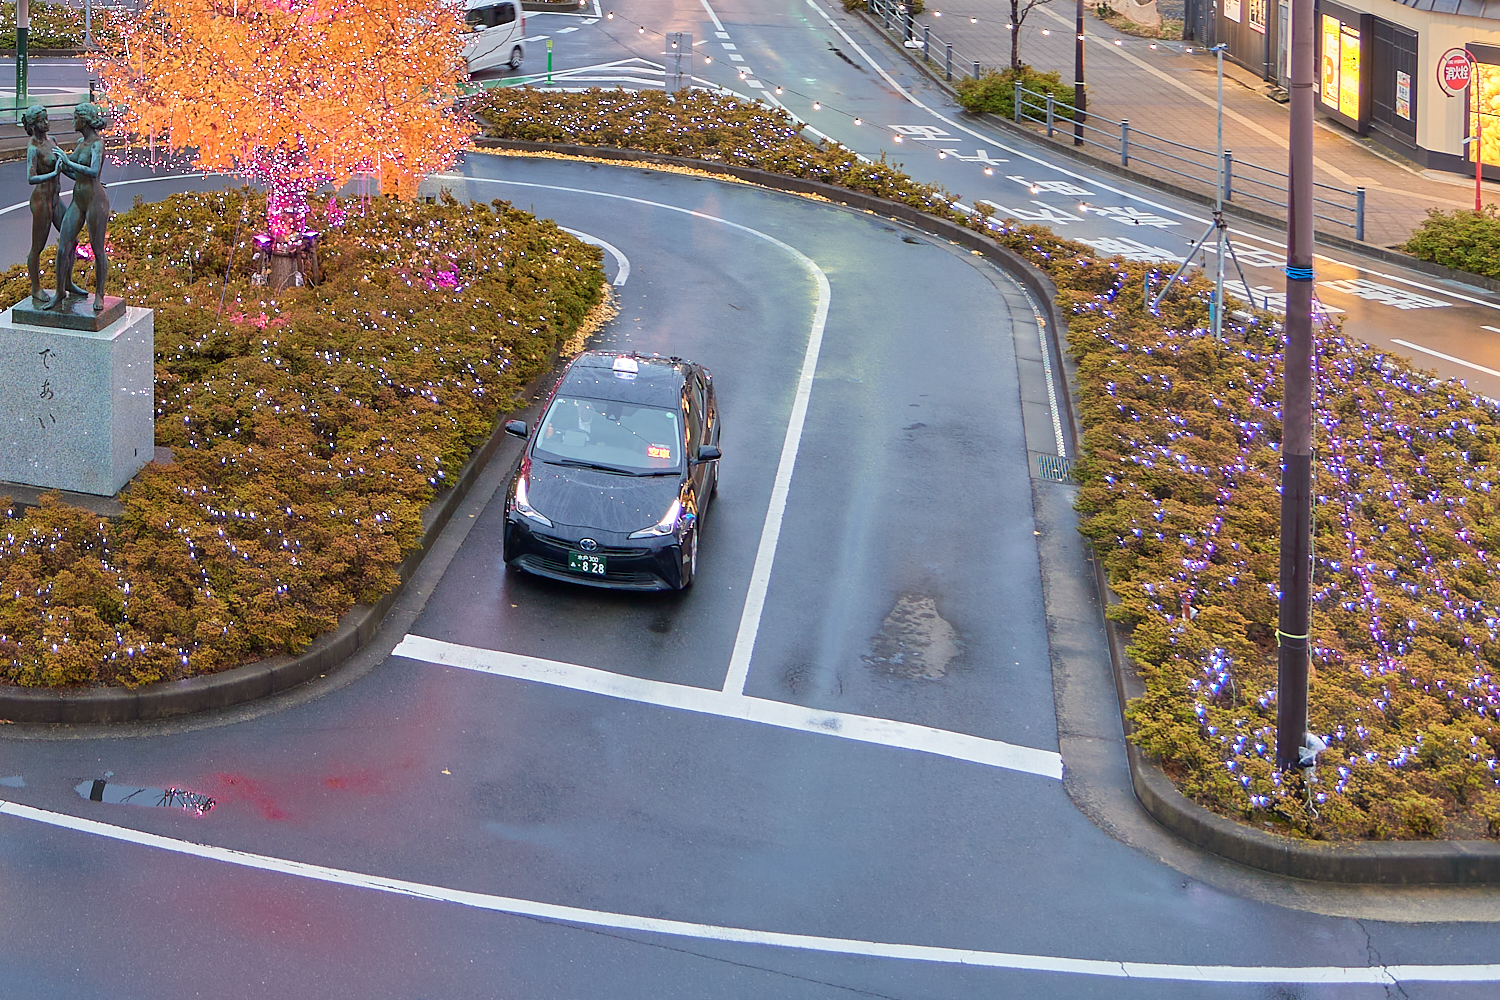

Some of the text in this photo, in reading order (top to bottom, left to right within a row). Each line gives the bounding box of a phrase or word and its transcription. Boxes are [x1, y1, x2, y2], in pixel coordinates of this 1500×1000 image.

[1445, 64, 1469, 81] 消火栓
[38, 348, 56, 429] であい
